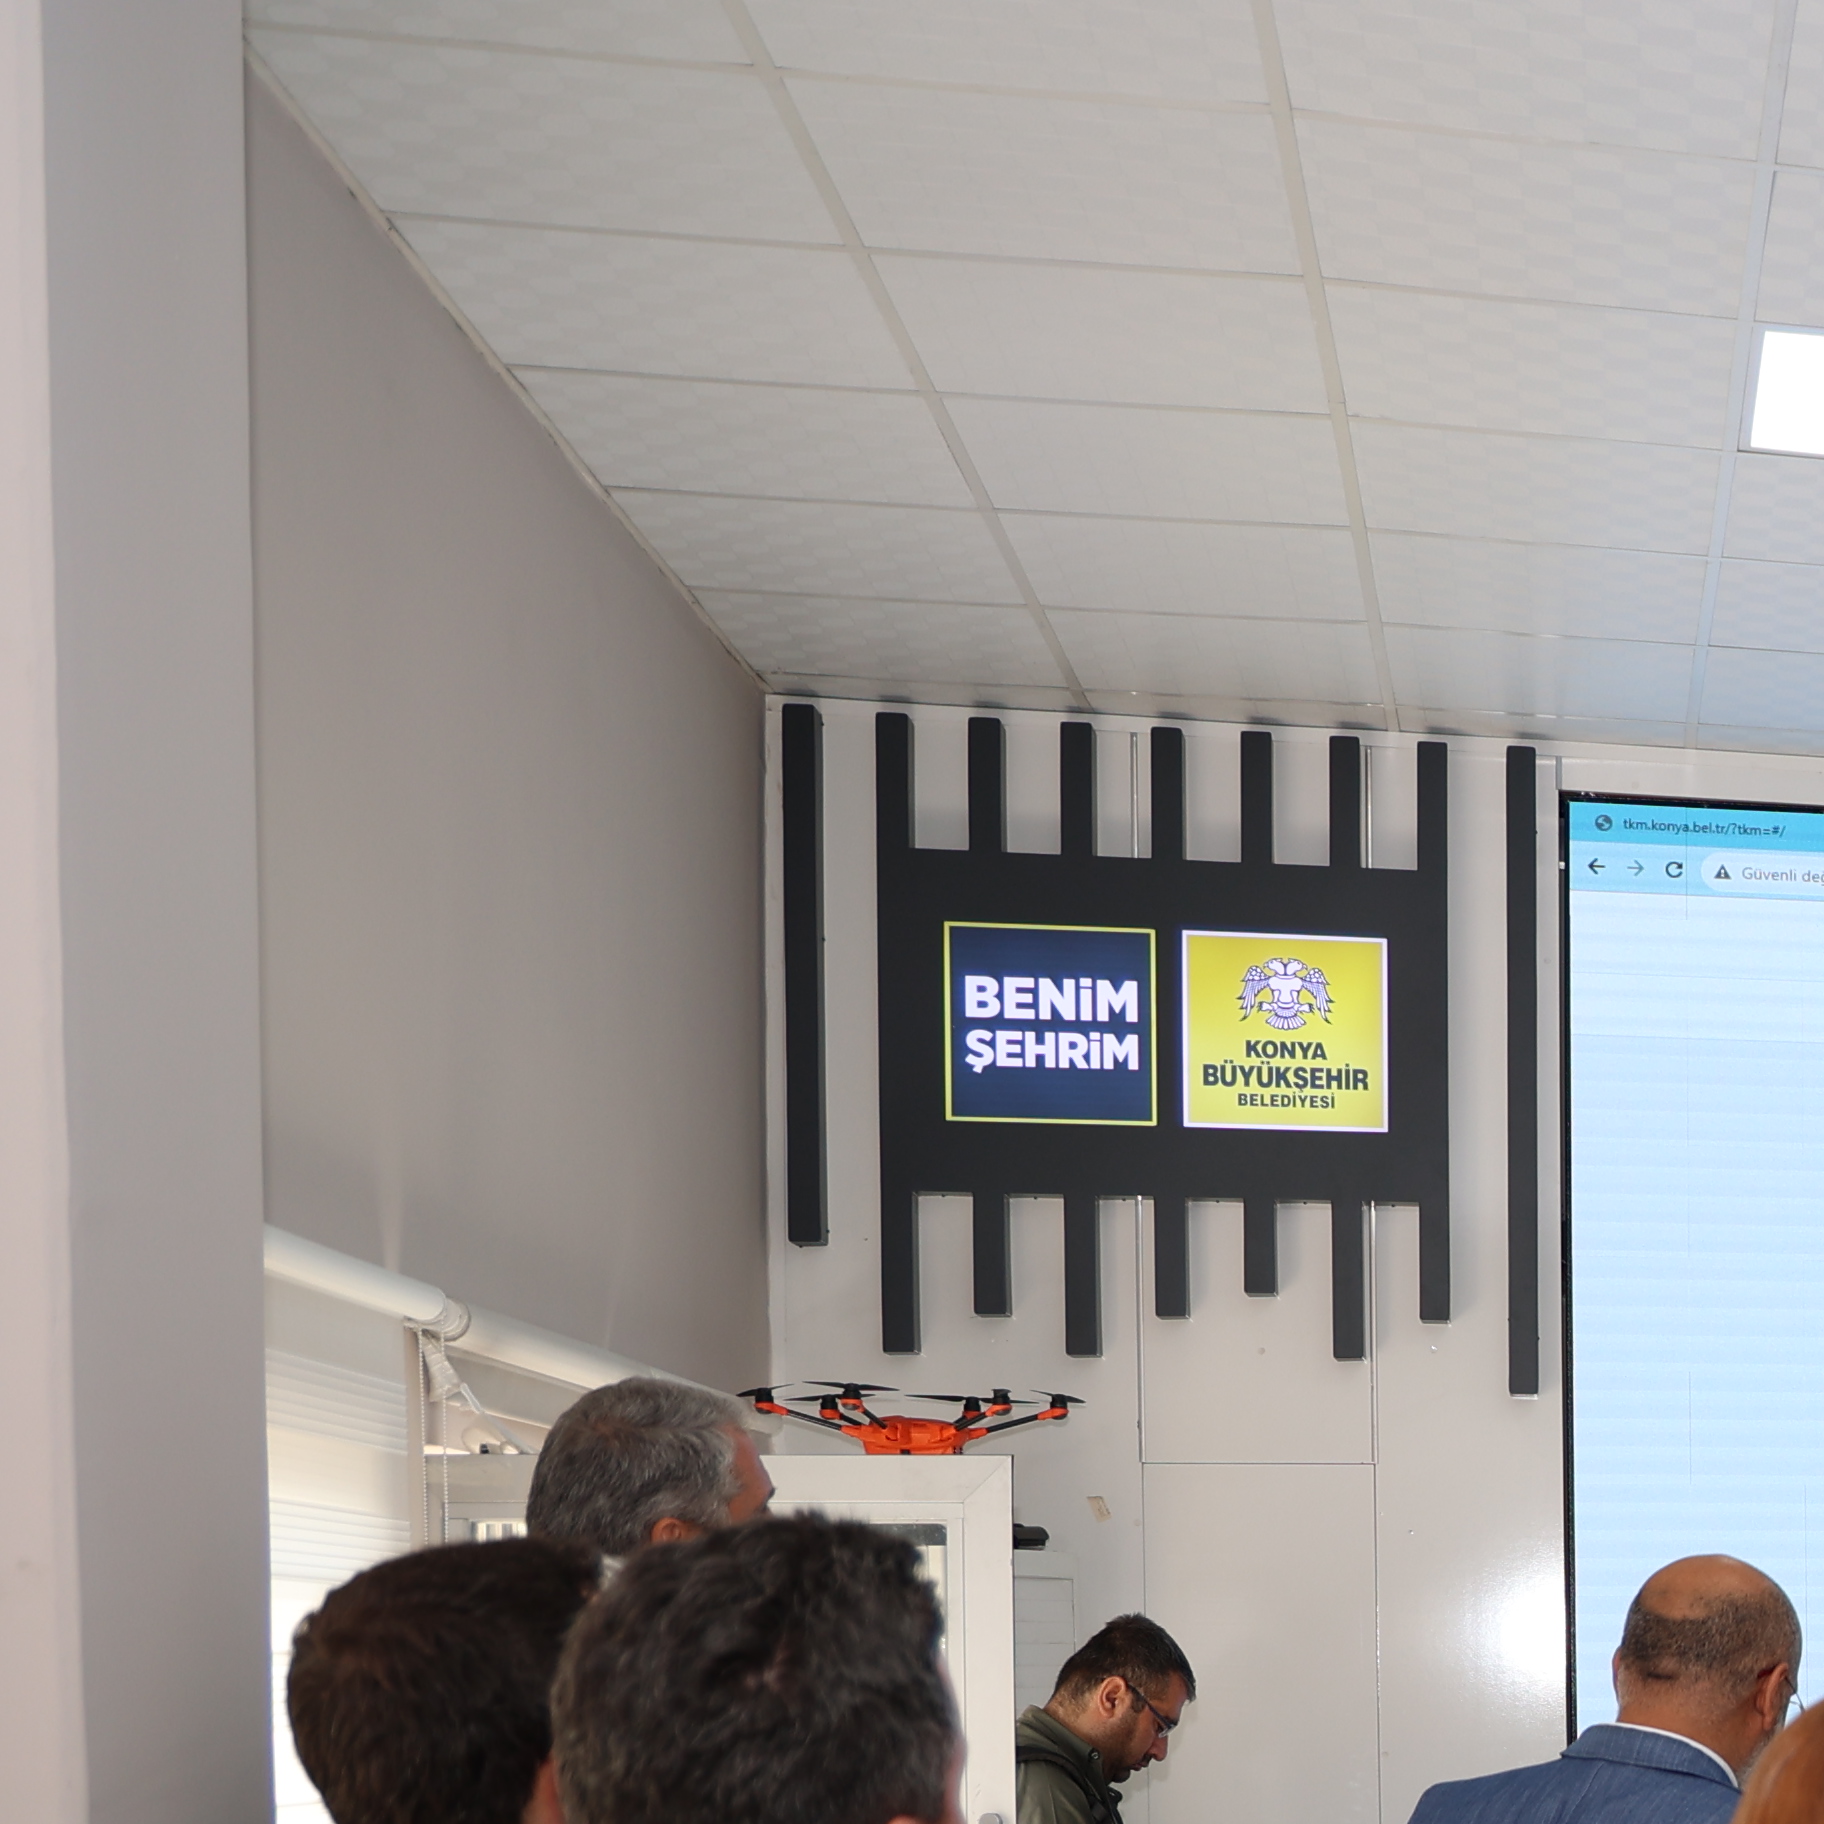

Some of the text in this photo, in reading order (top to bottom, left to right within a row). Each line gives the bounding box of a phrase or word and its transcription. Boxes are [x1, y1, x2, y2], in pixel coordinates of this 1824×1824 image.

[1623, 817, 1786, 838] tkm.konya.bel.tr/?tkm=#/
[1741, 865, 1798, 882] Güvenli
[1245, 1039, 1328, 1061] KONYA
[1202, 1058, 1370, 1094] BÜYÜKŞEHİR
[1238, 1090, 1336, 1109] BELEDİYESİ
